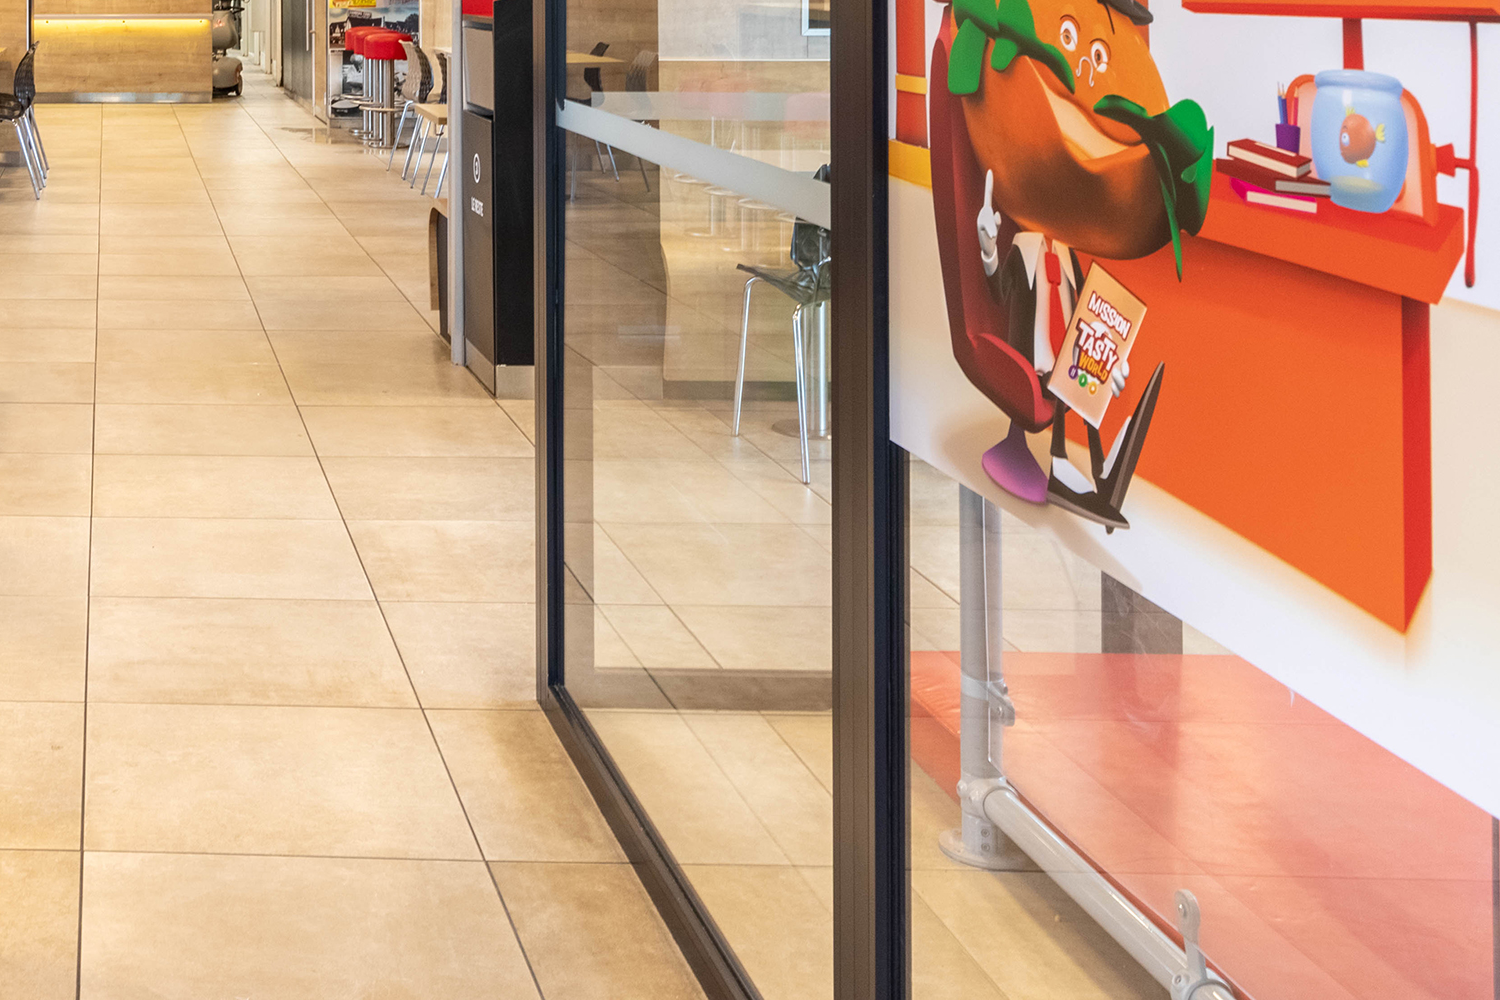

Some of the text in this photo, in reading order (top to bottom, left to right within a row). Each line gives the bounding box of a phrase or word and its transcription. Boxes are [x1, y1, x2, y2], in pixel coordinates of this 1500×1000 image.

[1088, 292, 1130, 339] MISSION
[1077, 321, 1118, 371] TASTY
[1079, 352, 1107, 382] WORLD
